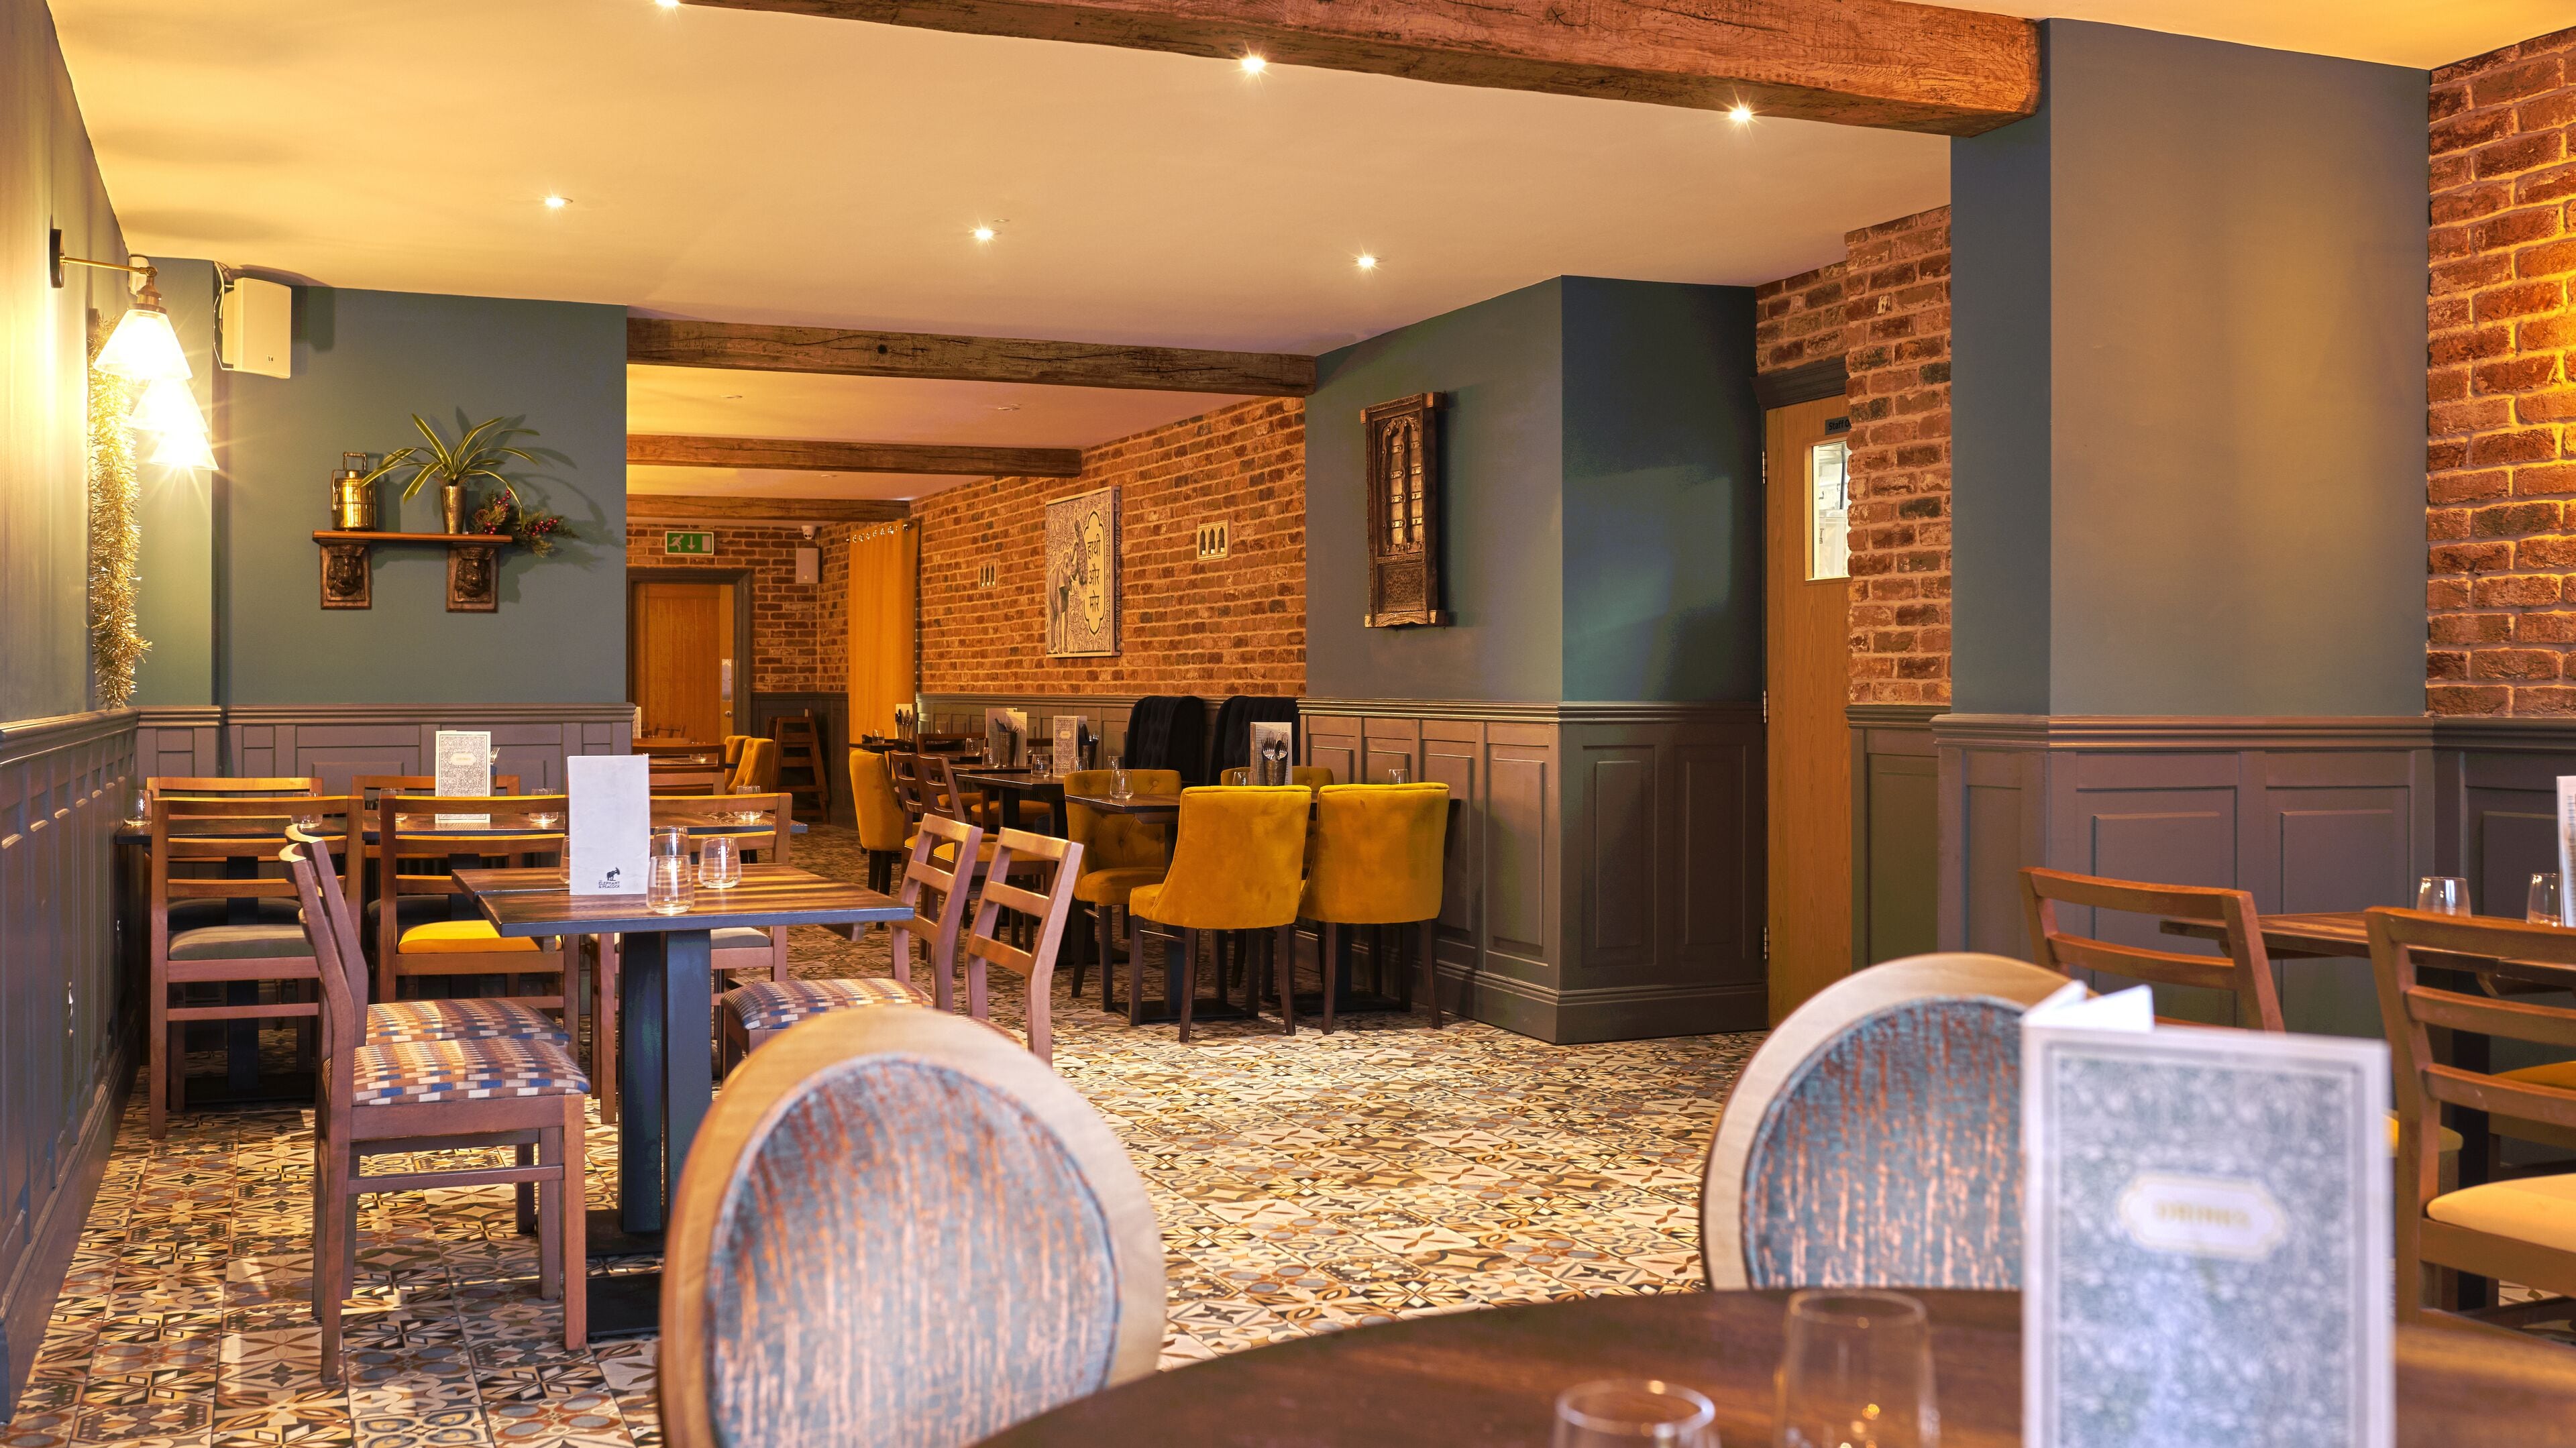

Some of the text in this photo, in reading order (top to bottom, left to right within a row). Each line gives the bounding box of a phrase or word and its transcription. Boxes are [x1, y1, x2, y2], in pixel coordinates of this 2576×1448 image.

[1829, 419, 1844, 431] Staff
[1087, 533, 1100, 559] हाथी
[1089, 563, 1099, 586] और
[1089, 590, 1099, 612] मोर
